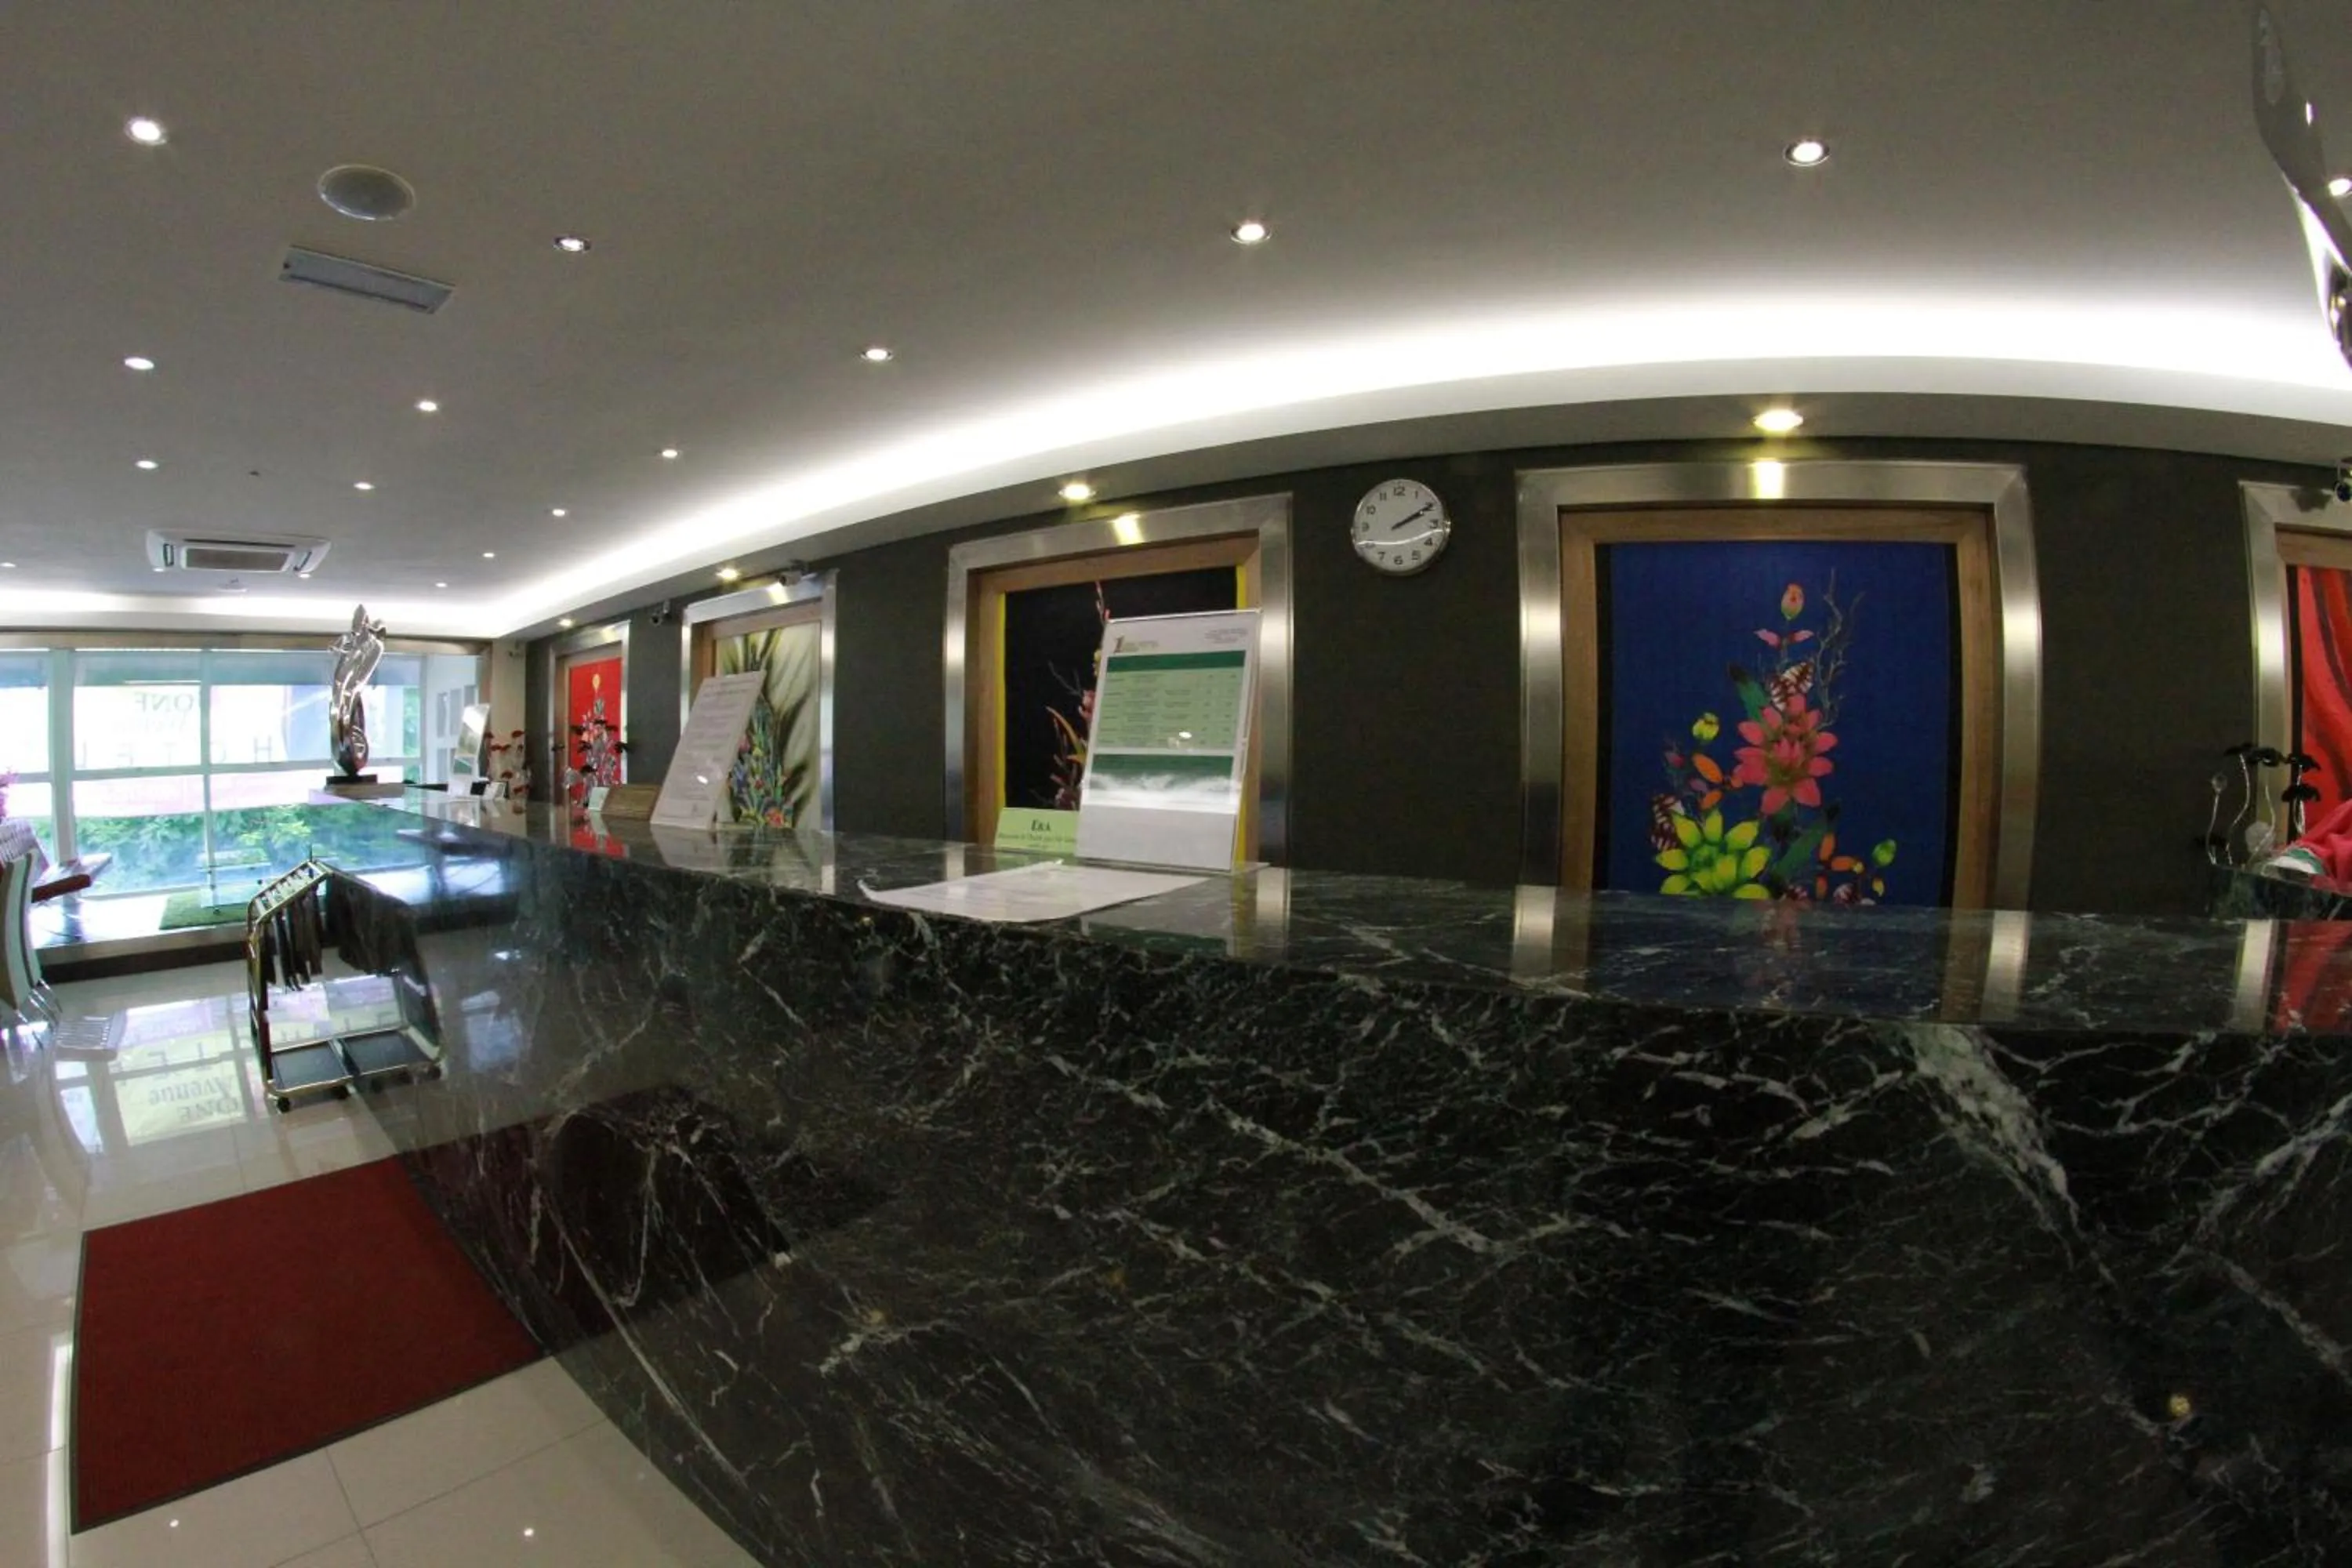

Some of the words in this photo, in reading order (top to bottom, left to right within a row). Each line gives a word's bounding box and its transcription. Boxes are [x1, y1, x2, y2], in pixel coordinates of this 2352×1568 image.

[1394, 486, 1405, 496] 12
[1380, 492, 1386, 502] 11
[1367, 505, 1376, 515] 10
[1362, 522, 1370, 532] 9
[1430, 519, 1438, 529] 3
[1424, 538, 1432, 546] 4
[1377, 551, 1385, 561] 7
[1394, 555, 1403, 565] 6
[1412, 550, 1421, 561] 5
